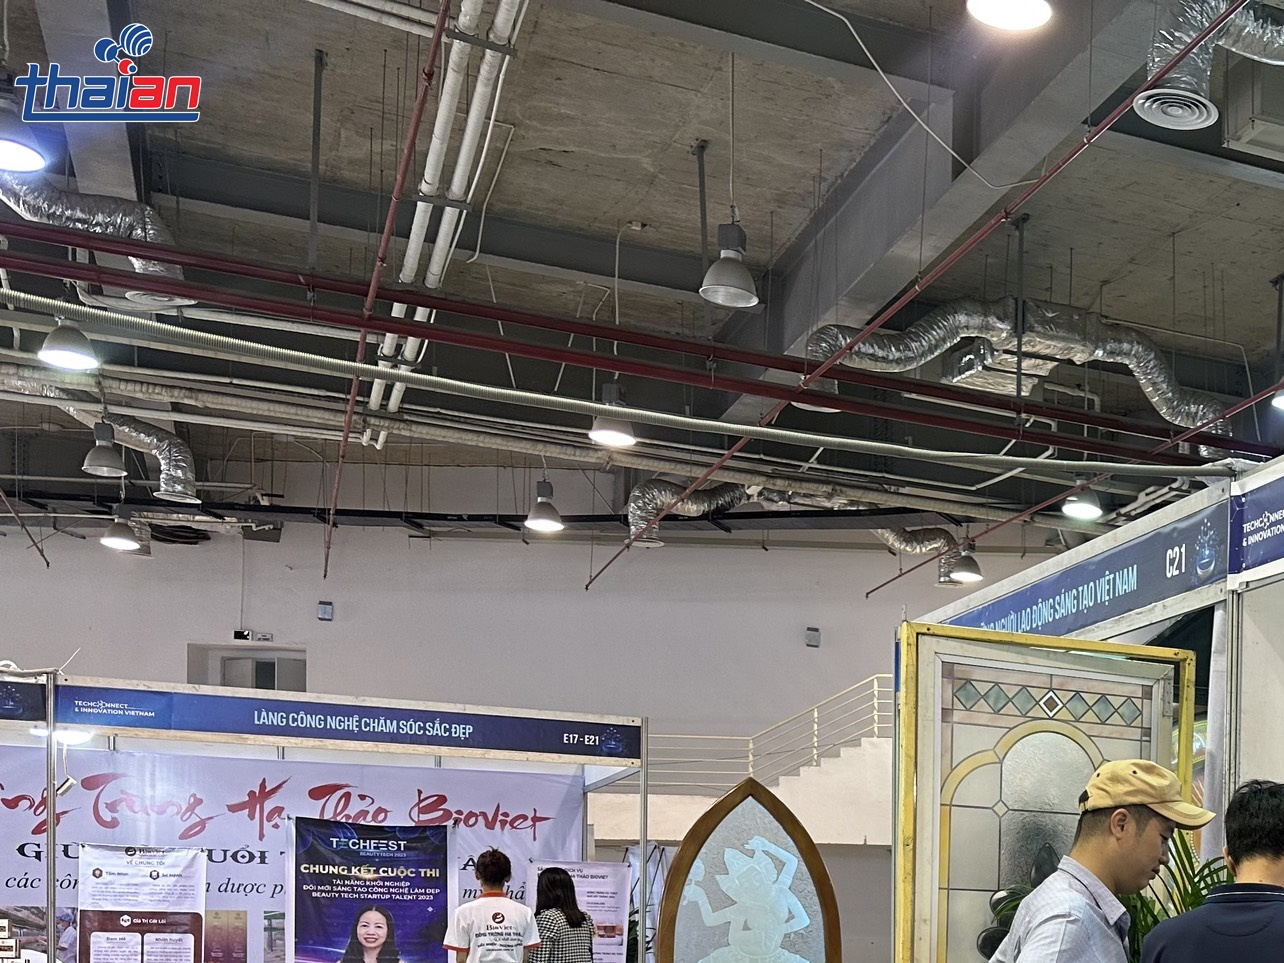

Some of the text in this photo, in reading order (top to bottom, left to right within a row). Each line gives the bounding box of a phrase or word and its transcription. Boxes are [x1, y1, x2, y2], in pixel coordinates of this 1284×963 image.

[1165, 543, 1186, 579] C21
[1032, 598, 1054, 630] ĐỘNG
[1055, 588, 1077, 618] SÁNG
[1078, 581, 1095, 614] TẠO
[1096, 570, 1115, 606] VIỆT
[1116, 564, 1137, 597] NAM
[80, 707, 124, 715] INNOVATION
[254, 708, 473, 741] LÀNG CÔNG NGHỆ CHĂM SÓC SẮC ĐẸP
[206, 844, 269, 865] UỔI
[329, 837, 407, 851] TECHFEST
[300, 863, 440, 878] CHUNG KẾT CUỘC THI
[5, 872, 41, 889] các
[218, 878, 266, 896] dược
